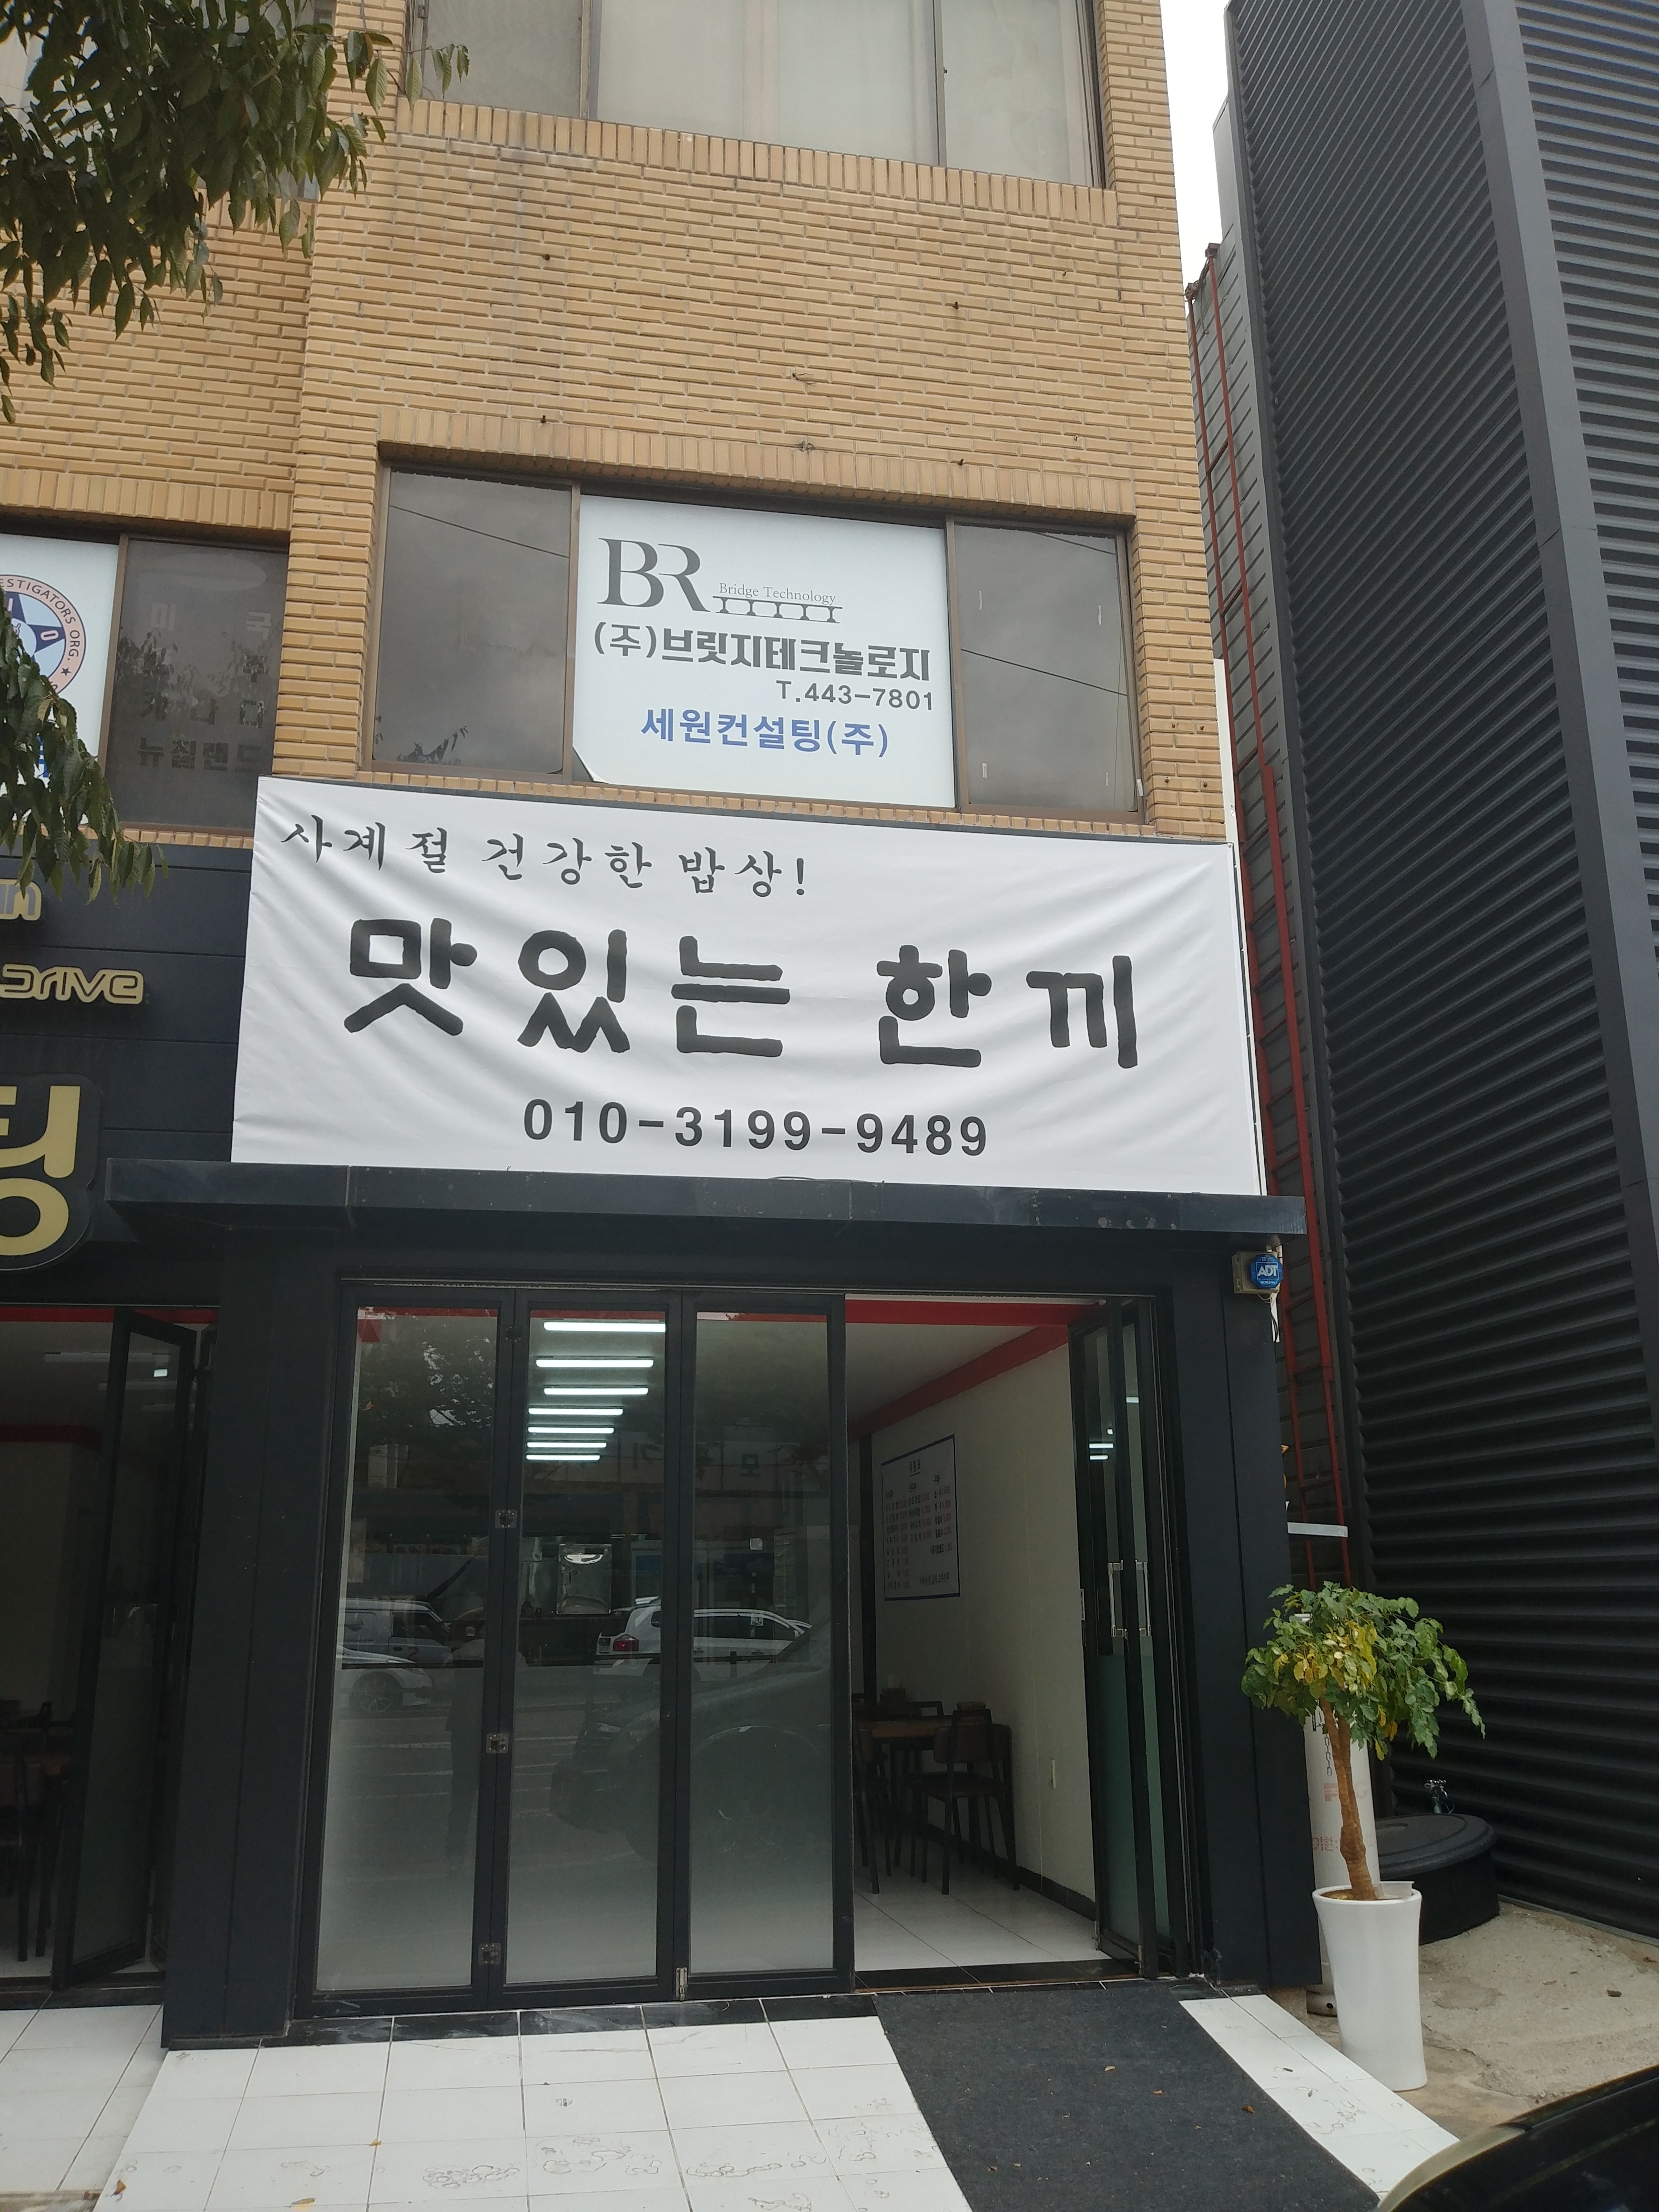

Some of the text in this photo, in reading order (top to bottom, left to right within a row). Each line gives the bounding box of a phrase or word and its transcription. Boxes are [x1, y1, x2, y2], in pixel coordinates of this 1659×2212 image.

[597, 538, 711, 613] BR
[719, 582, 837, 605] Bridge Technology
[67, 629, 81, 661] ORG.
[594, 621, 930, 682] (주)브릿지테크놀로지
[776, 679, 933, 711] T.443-7801
[641, 708, 889, 758] 세원컨설팅(주)
[281, 815, 805, 897] 사계절 건강한 밥상!
[344, 918, 1138, 1069] 맛있는 한끼
[524, 1099, 986, 1156] 010-3199-9489
[1258, 1264, 1278, 1277] ADT
